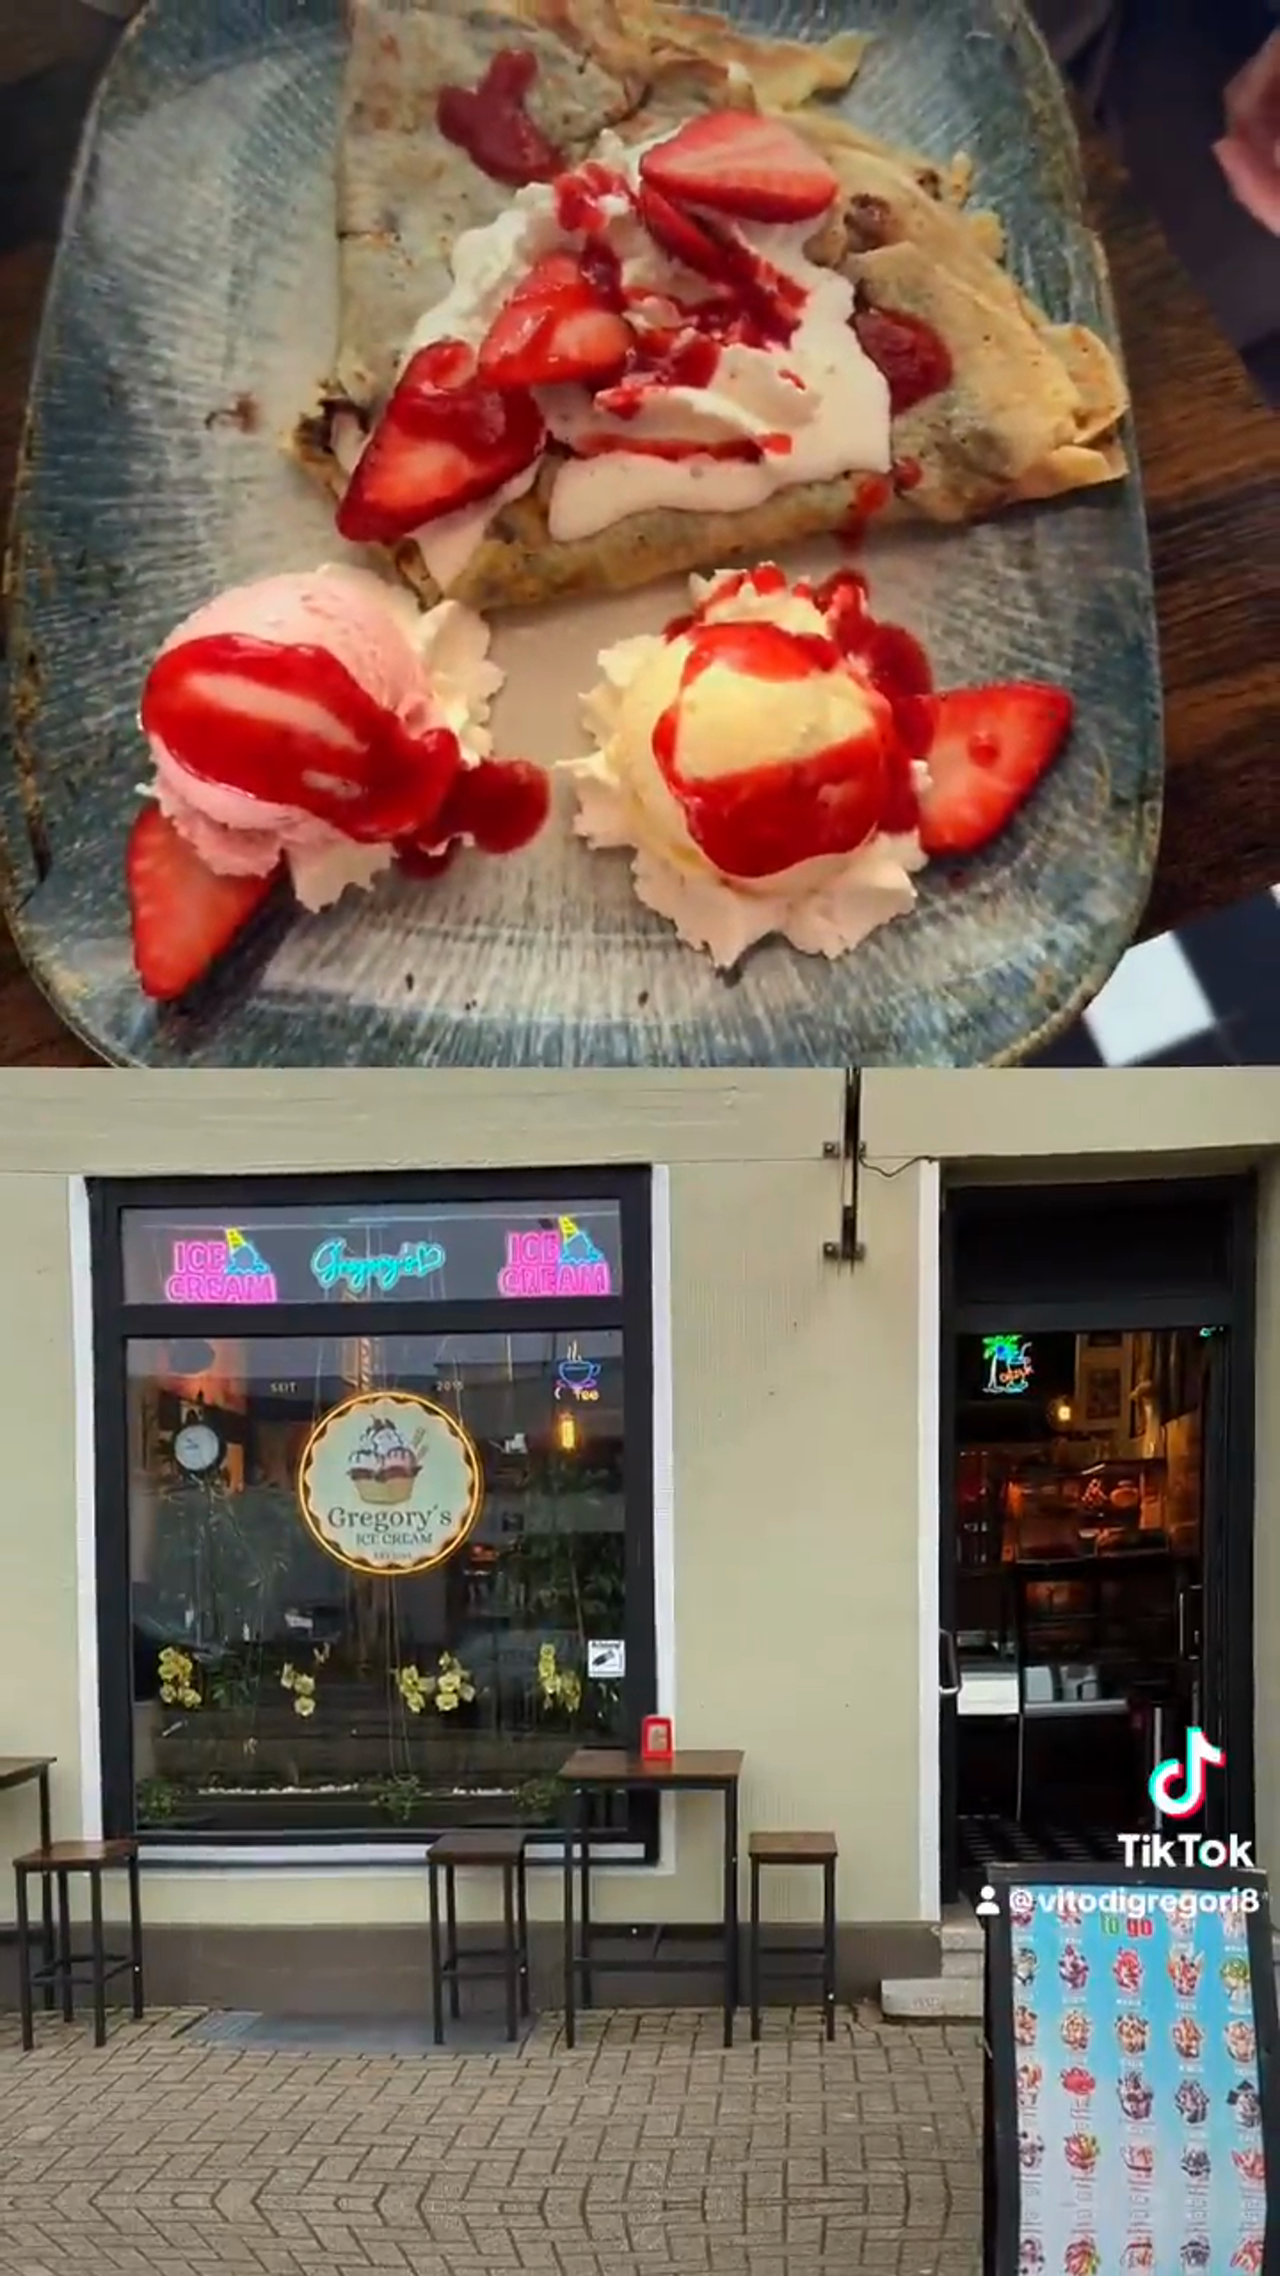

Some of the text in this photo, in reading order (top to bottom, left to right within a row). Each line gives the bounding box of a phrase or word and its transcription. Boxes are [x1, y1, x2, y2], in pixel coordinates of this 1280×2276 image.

[174, 1241, 227, 1273] ICE
[506, 1231, 560, 1264] ICE
[165, 1273, 278, 1303] CREAM
[498, 1262, 611, 1296] CREAM
[356, 1532, 433, 1545] ICE CREAM
